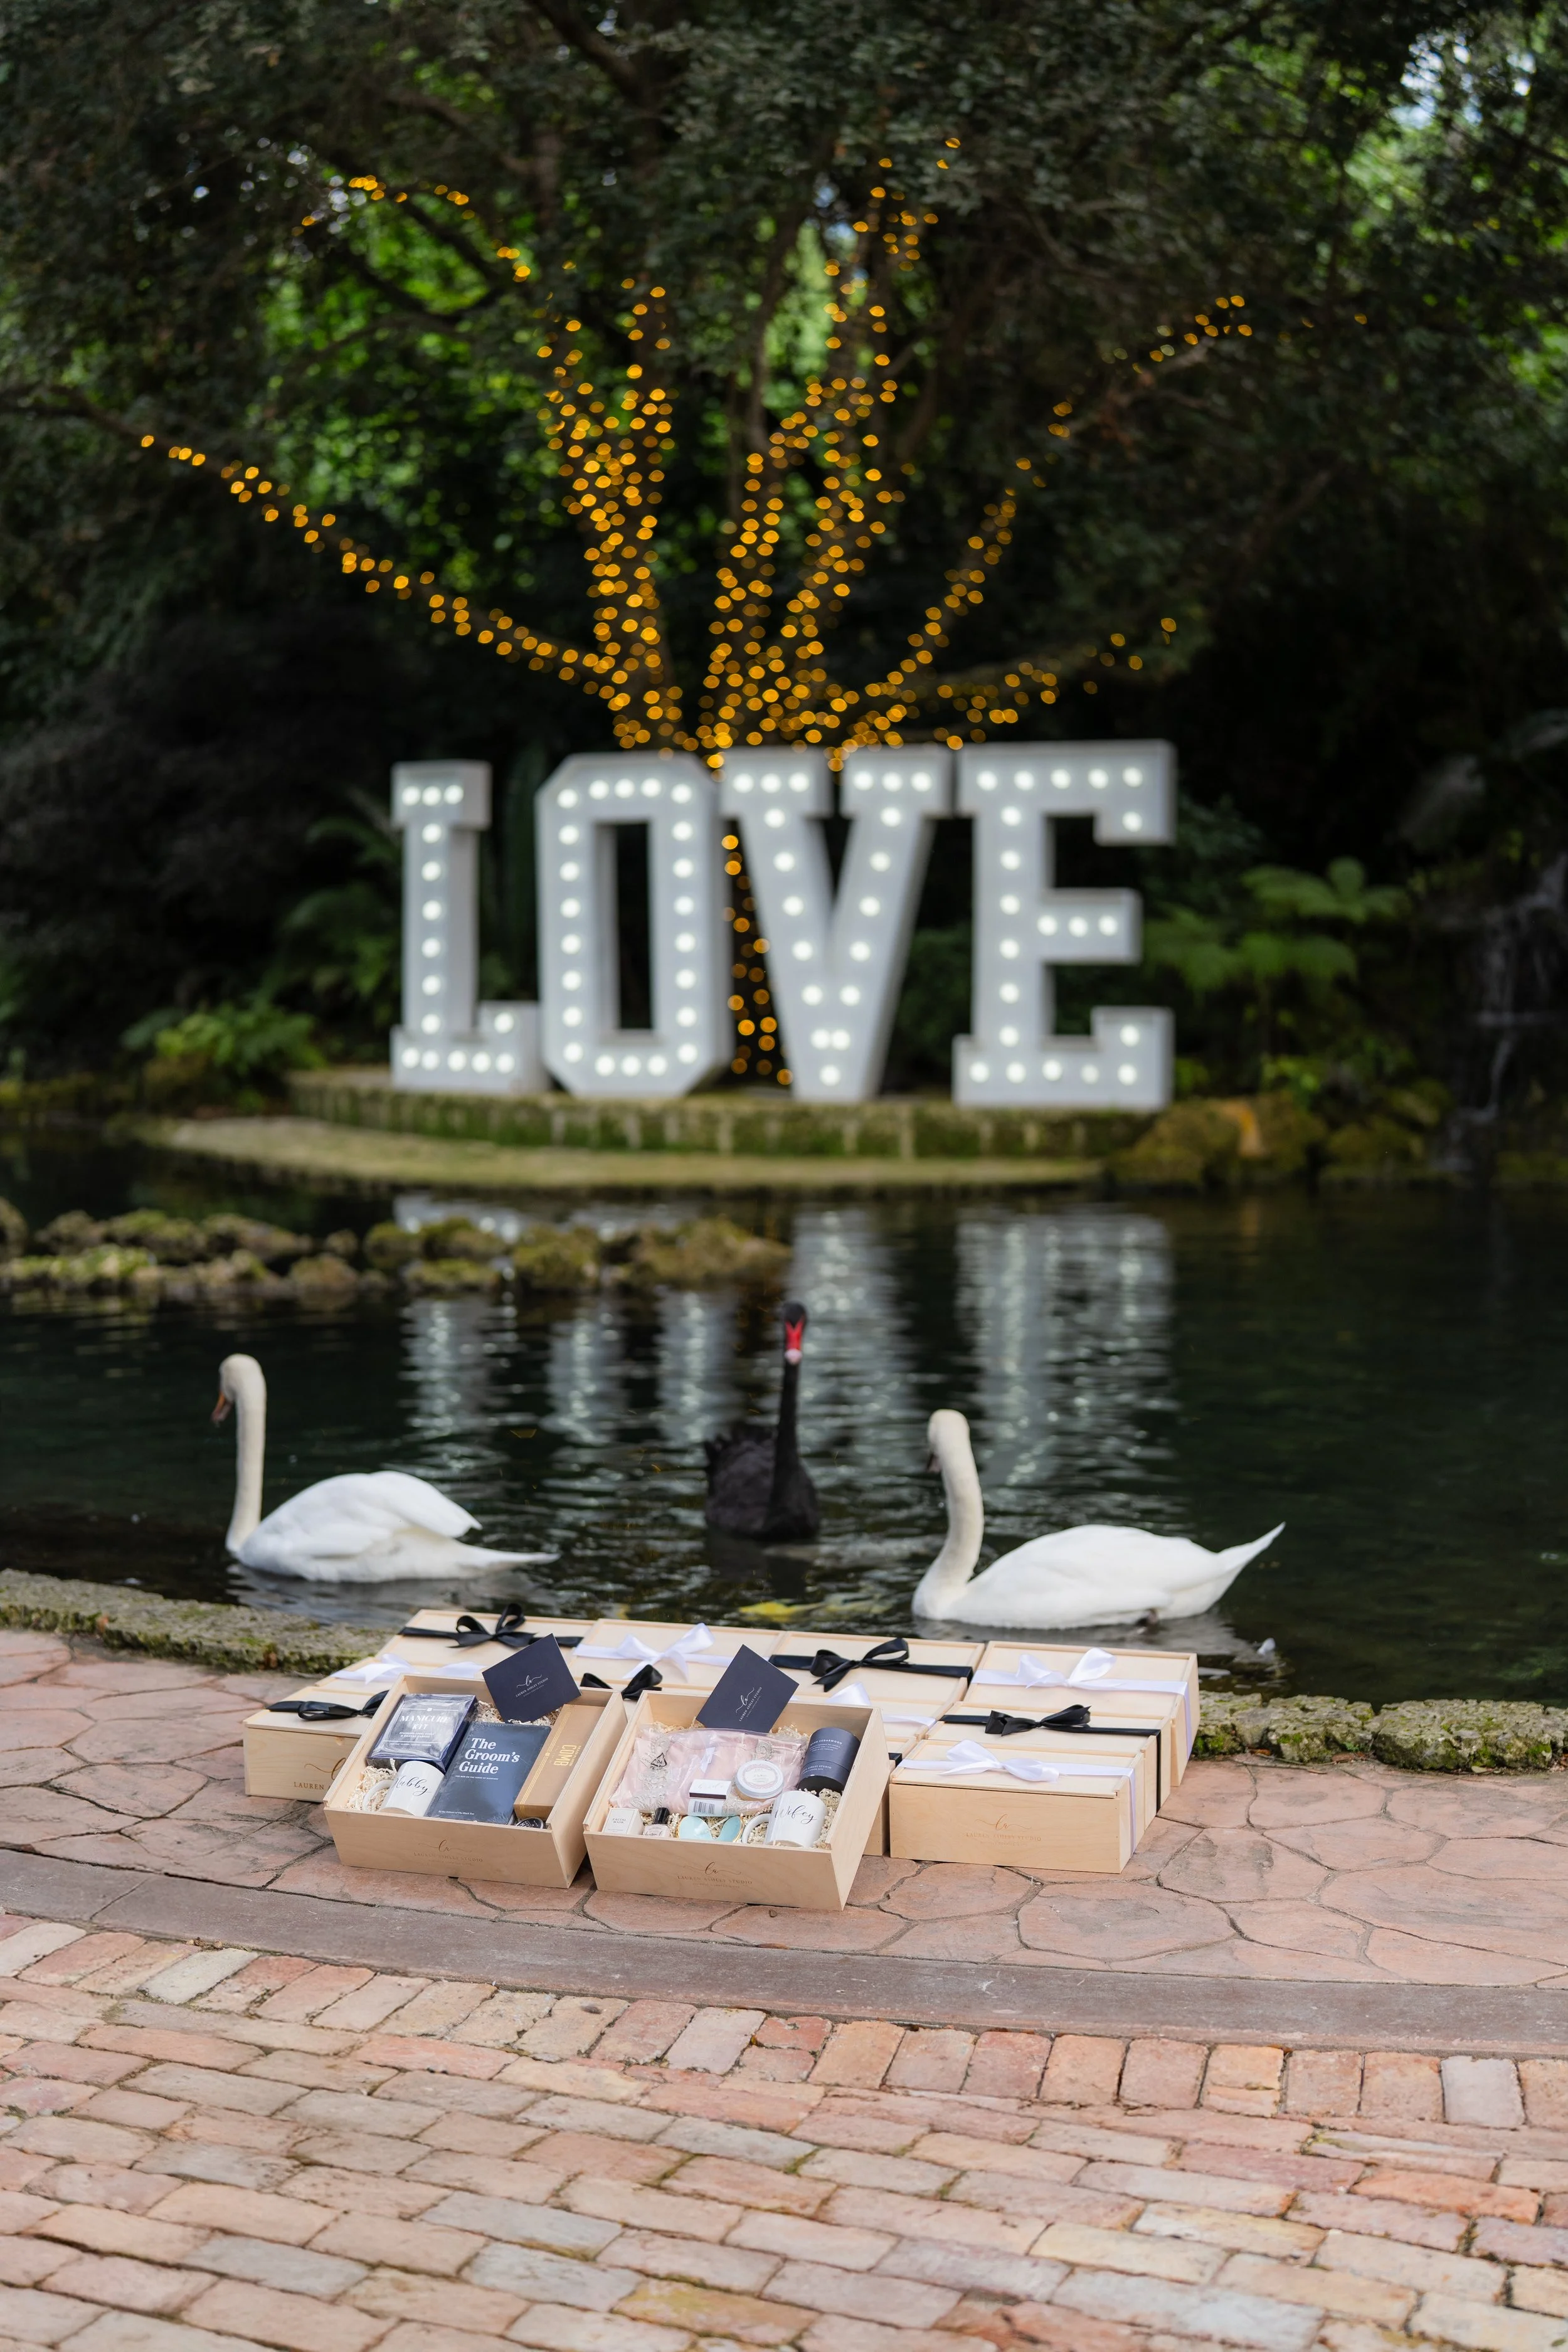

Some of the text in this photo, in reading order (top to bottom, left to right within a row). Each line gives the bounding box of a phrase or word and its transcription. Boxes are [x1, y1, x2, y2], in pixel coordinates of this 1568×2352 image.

[390, 740, 1176, 1111] LOVE
[516, 1690, 527, 1698] LAUREN
[538, 1677, 549, 1685] STUDIO
[738, 1710, 748, 1722] LAUREN
[753, 1687, 763, 1698] STUDIO
[470, 1738, 497, 1750] The
[465, 1749, 521, 1762] Groom's
[554, 1745, 576, 1766] COMB
[458, 1761, 499, 1774] Guide
[294, 1782, 324, 1790] LAUREN
[390, 1776, 432, 1796] Hubby
[775, 1805, 817, 1824] Wifey
